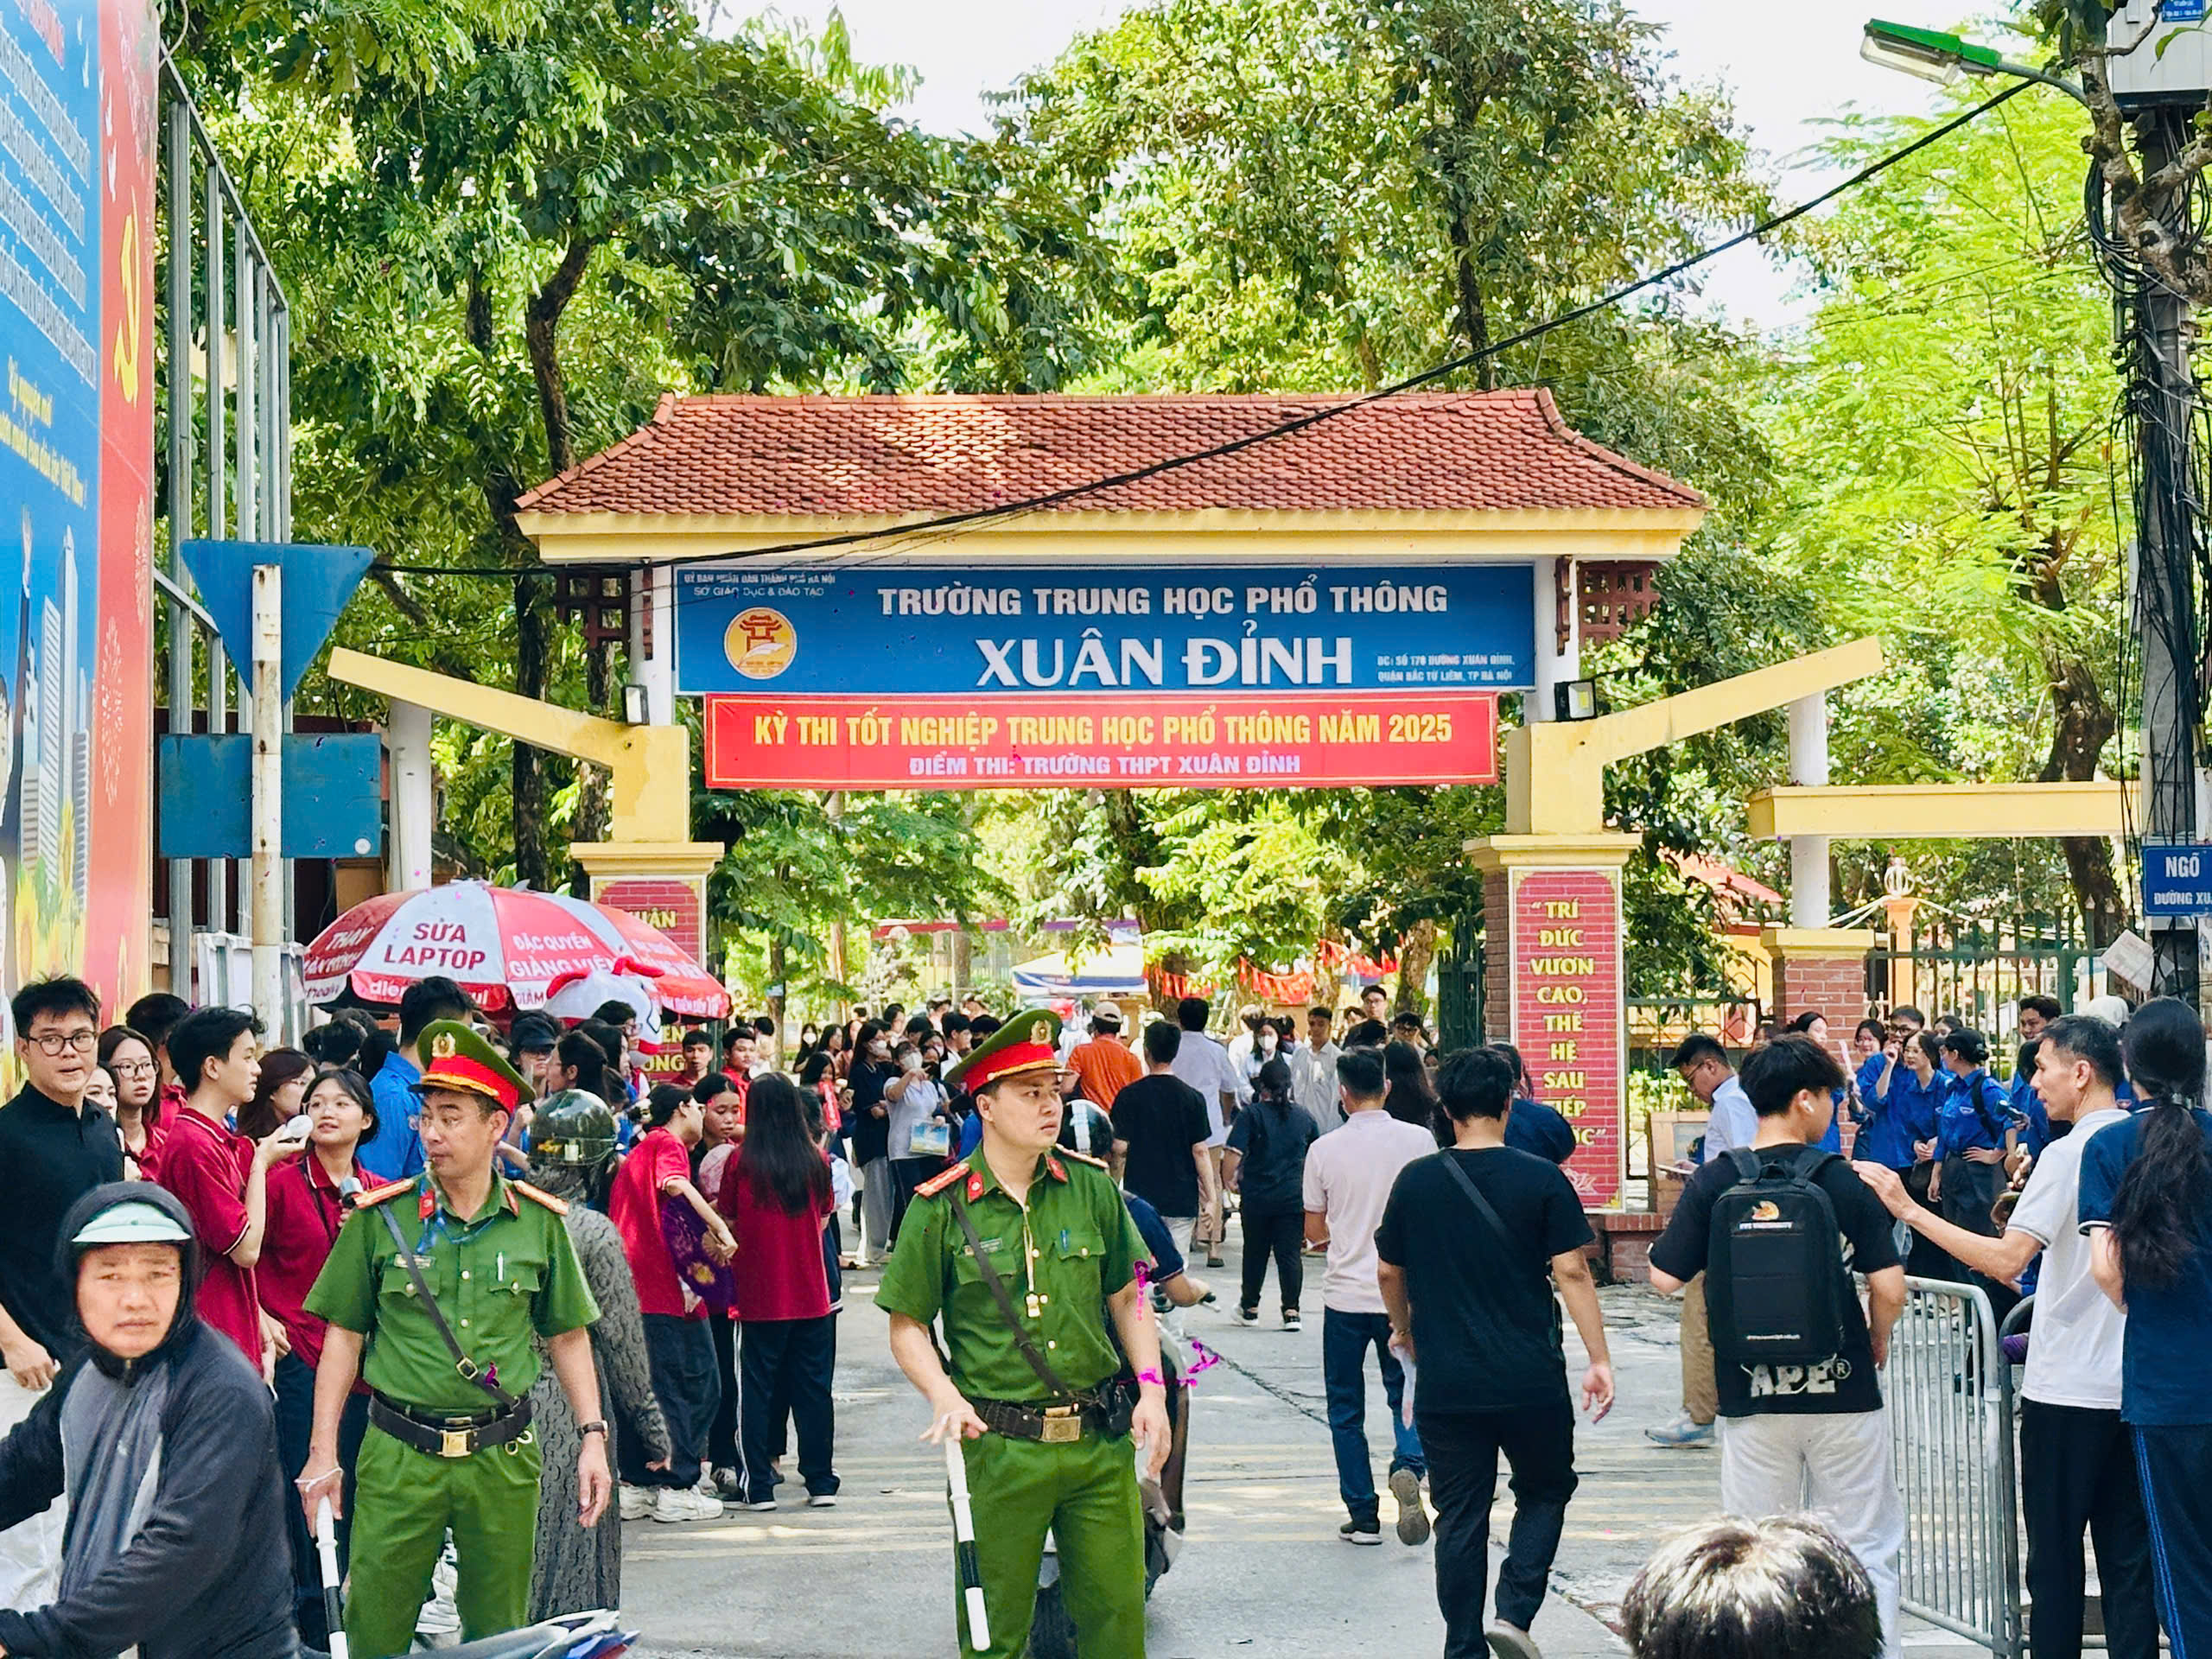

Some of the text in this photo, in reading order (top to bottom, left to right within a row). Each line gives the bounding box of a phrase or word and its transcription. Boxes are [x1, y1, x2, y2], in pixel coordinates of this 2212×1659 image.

[767, 588, 775, 596] &
[878, 574, 1447, 620] TRƯỜNG TRUNG HỌC PHỔ THÔNG
[976, 620, 1352, 687] XUÂN ĐỈNH
[1468, 671, 1480, 681] TP
[755, 704, 1452, 752] KỲ THI TỐT NGHIỆP TRUNG HỌC PHỔ THÔNG NĂM 2025
[909, 748, 1300, 776] ĐIỂM THI: TRƯỜNG THPT XUÂN ĐỈNH
[2165, 852, 2200, 878] NGÕ
[2154, 889, 2212, 905] ĐƯỜNG XU
[414, 918, 467, 944] SỬA
[1539, 925, 1584, 947] ĐỨC
[384, 944, 486, 970] LAPTOP
[1530, 957, 1594, 976] VƯƠN
[1536, 986, 1588, 1005] CAO,
[1543, 1010, 1584, 1033] THẾ
[1550, 1039, 1578, 1064] HỆ
[1543, 1071, 1585, 1090] SAU
